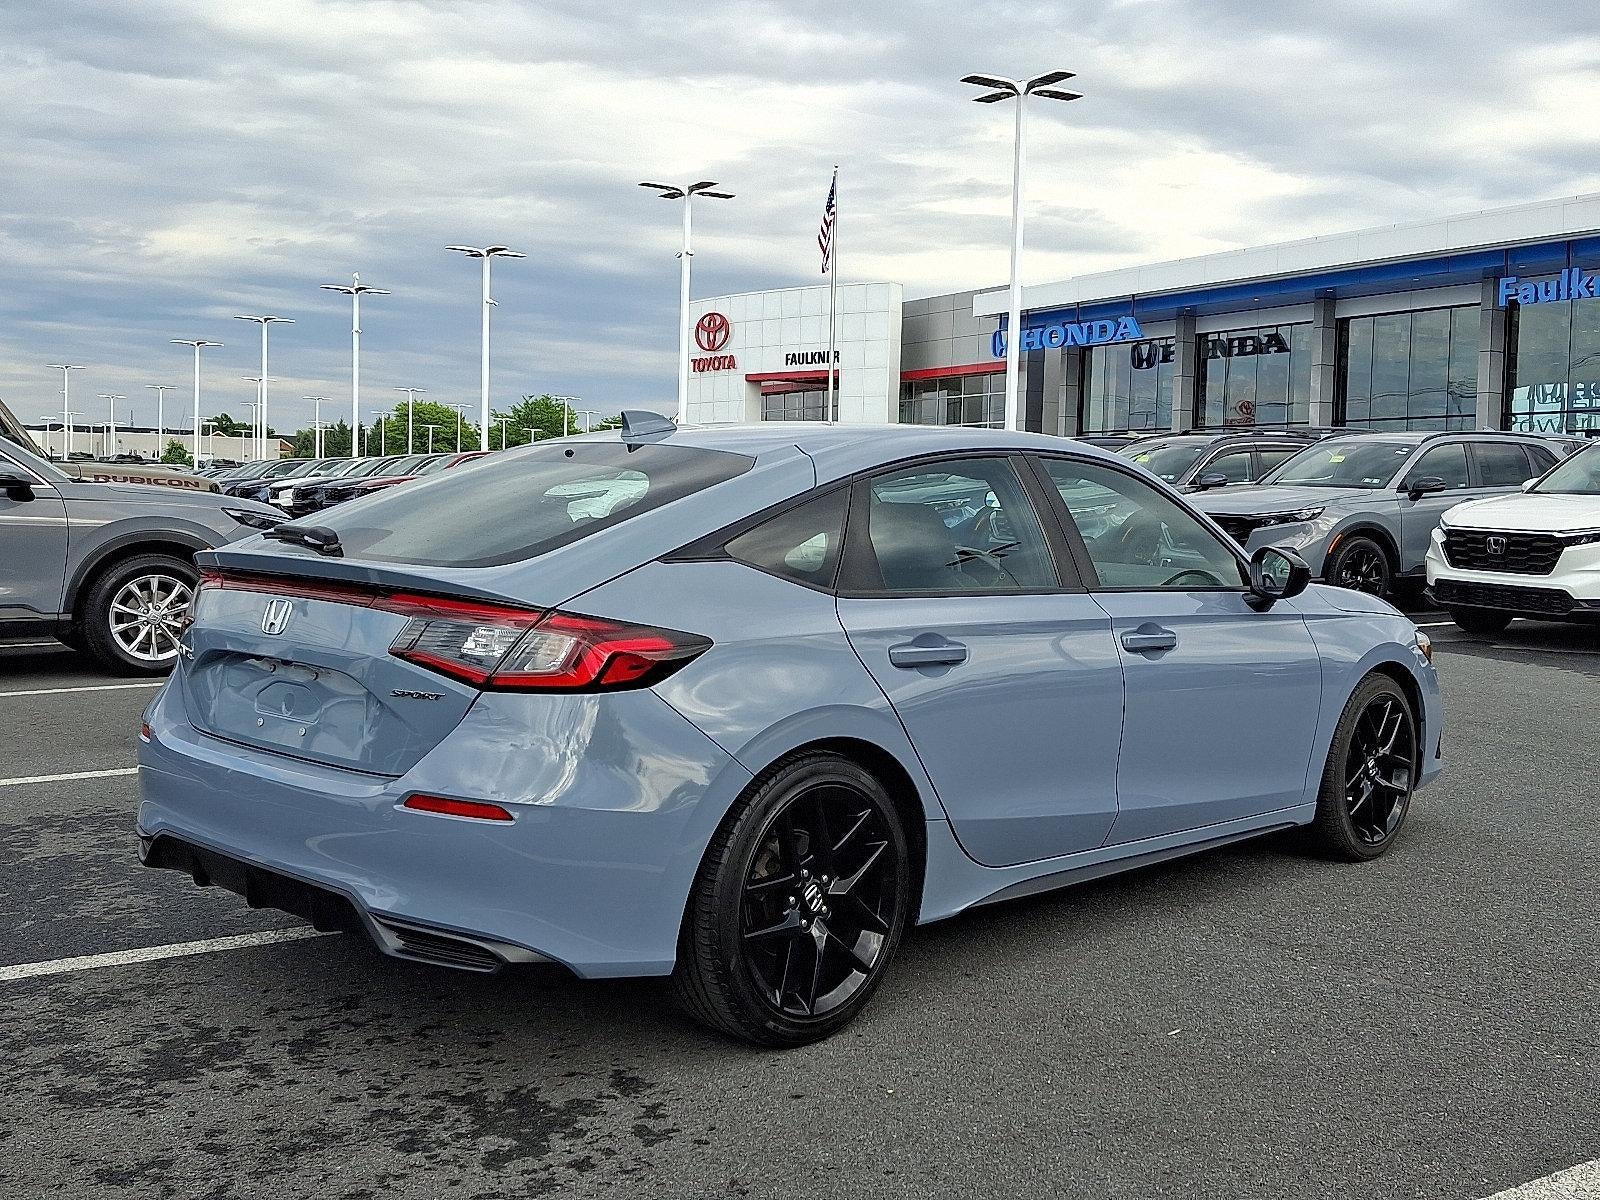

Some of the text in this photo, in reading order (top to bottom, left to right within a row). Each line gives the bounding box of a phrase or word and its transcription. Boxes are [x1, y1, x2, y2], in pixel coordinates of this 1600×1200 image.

[1018, 316, 1144, 351] HONDA
[691, 355, 737, 373] TOYOTA
[94, 474, 200, 488] RUBICON
[389, 688, 446, 700] SPORT
